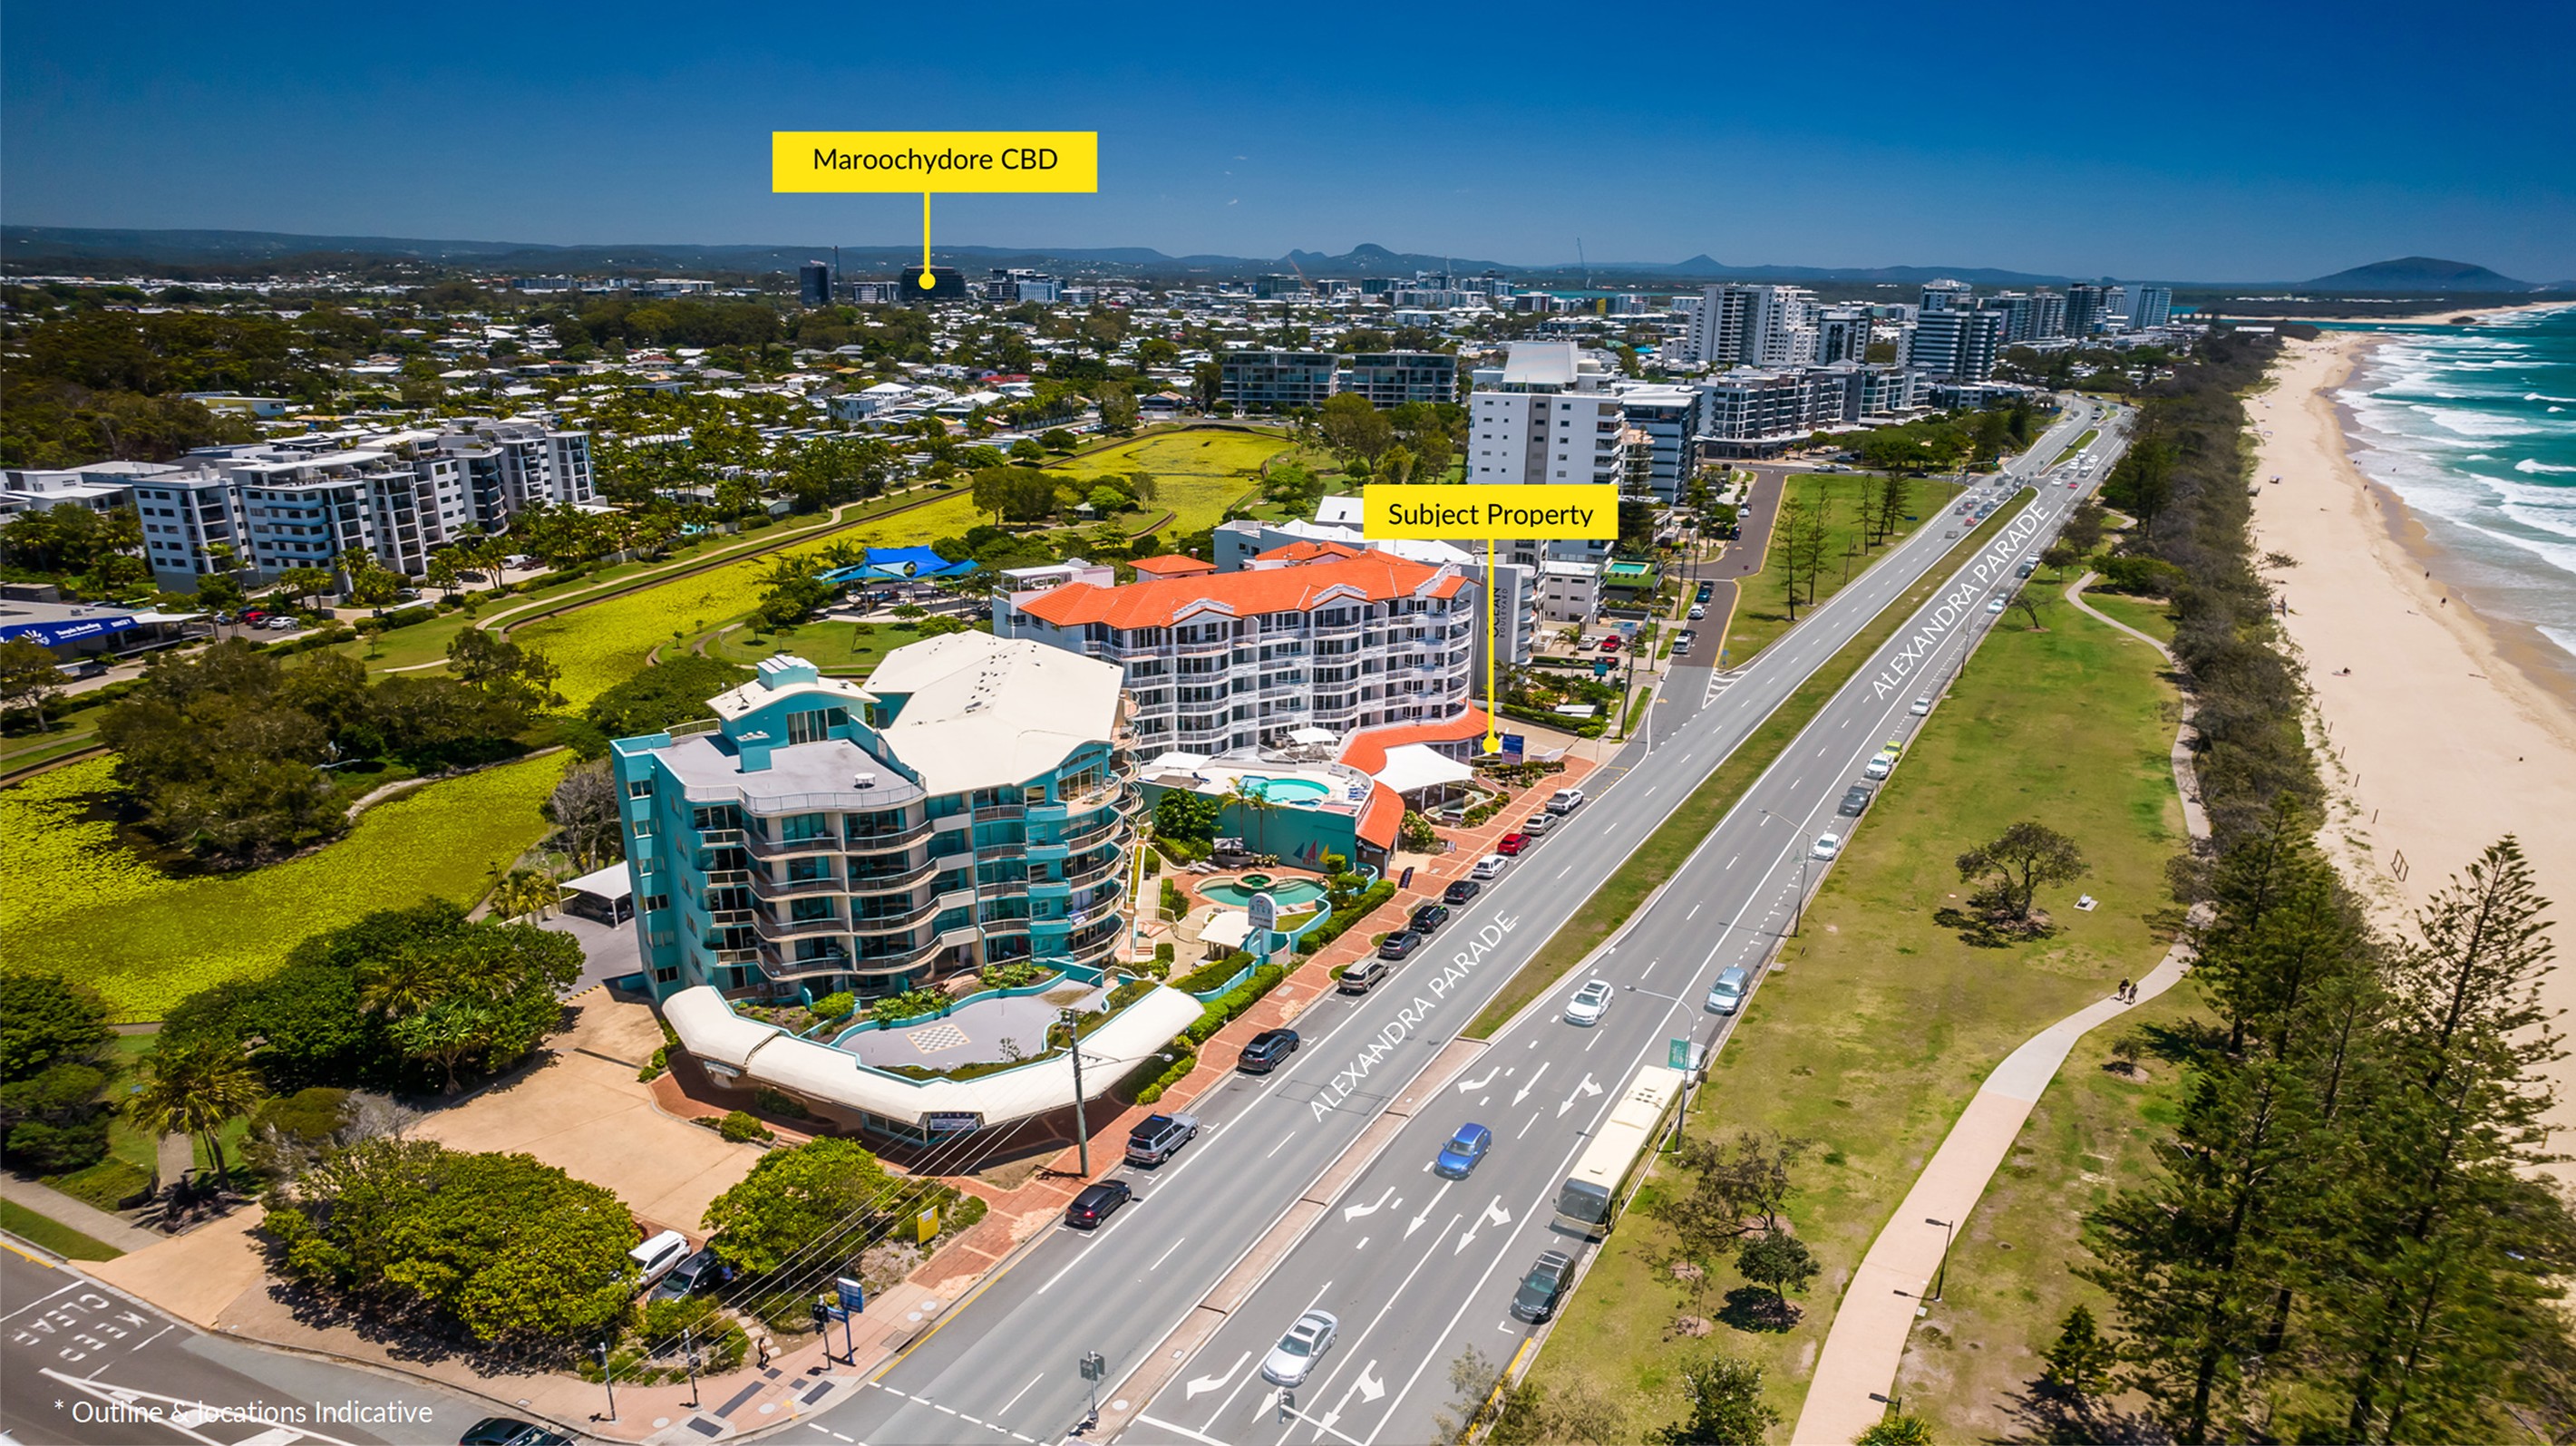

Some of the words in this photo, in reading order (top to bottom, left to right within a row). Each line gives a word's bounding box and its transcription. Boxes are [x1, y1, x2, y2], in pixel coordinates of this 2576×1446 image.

[1499, 587, 1509, 638] BOULEVARD
[13, 1294, 110, 1346] CLEAR
[58, 1310, 150, 1362] KEEP
